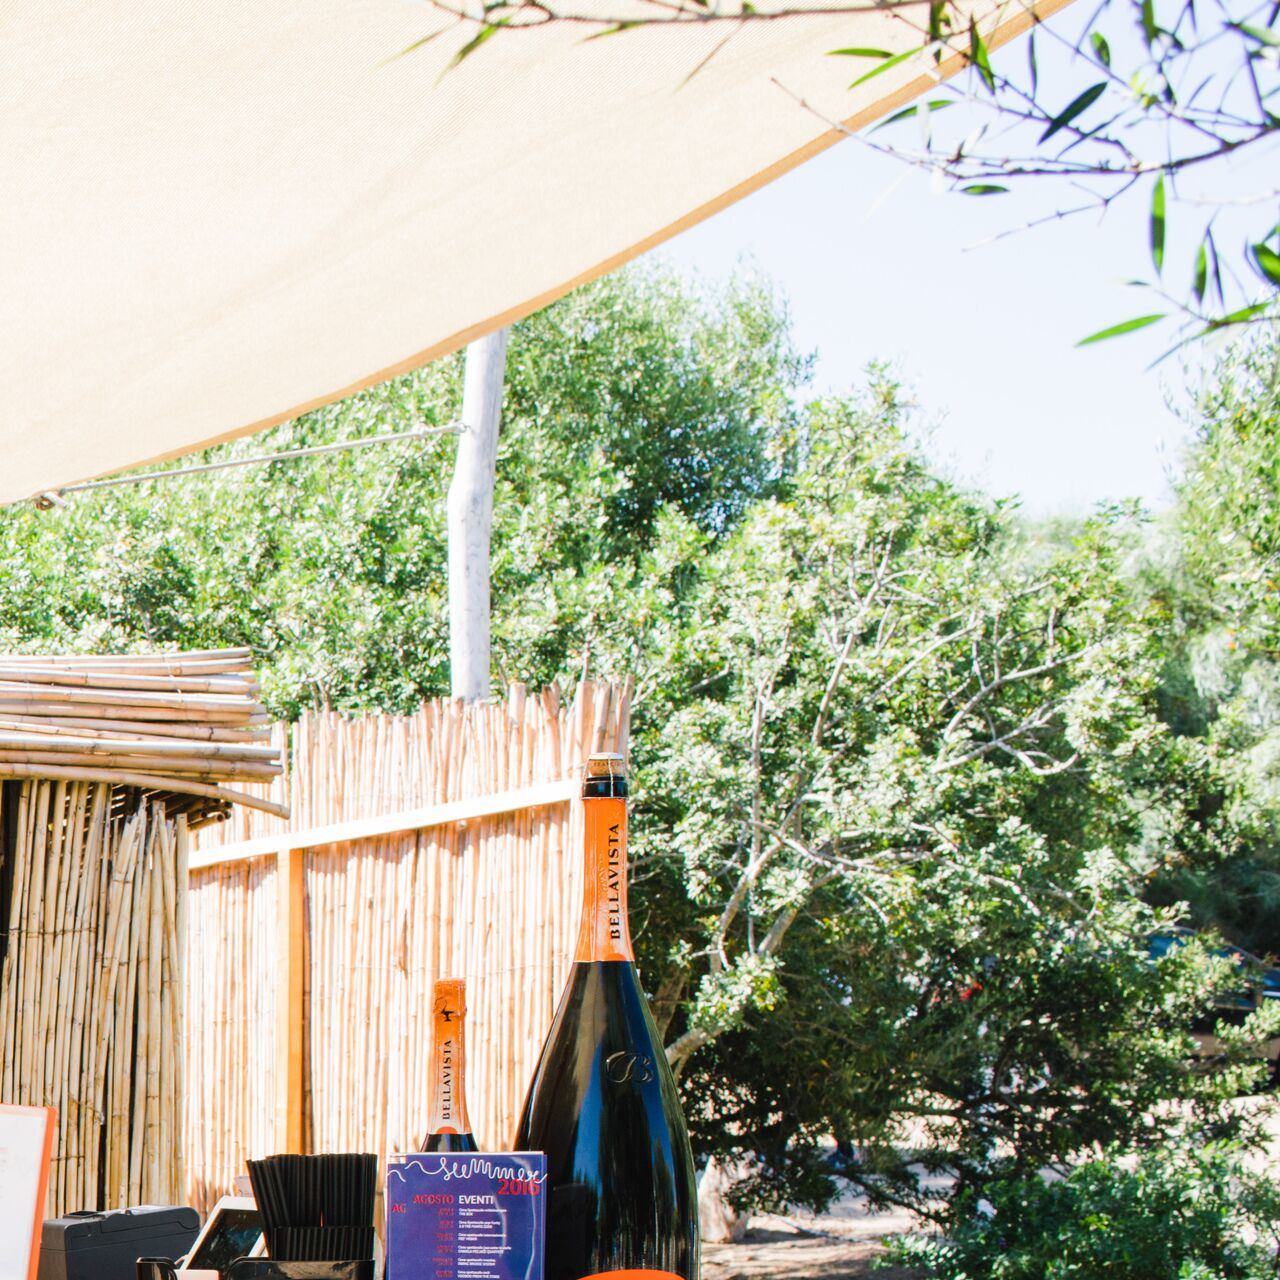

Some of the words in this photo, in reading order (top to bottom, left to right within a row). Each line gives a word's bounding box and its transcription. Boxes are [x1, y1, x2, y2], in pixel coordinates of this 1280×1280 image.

[608, 823, 621, 940] BELLAVISTA
[442, 1040, 452, 1120] BELLAVISTA
[413, 1194, 455, 1204] AGOSTO
[458, 1195, 494, 1205] EVENTI
[497, 1178, 540, 1196] 2016
